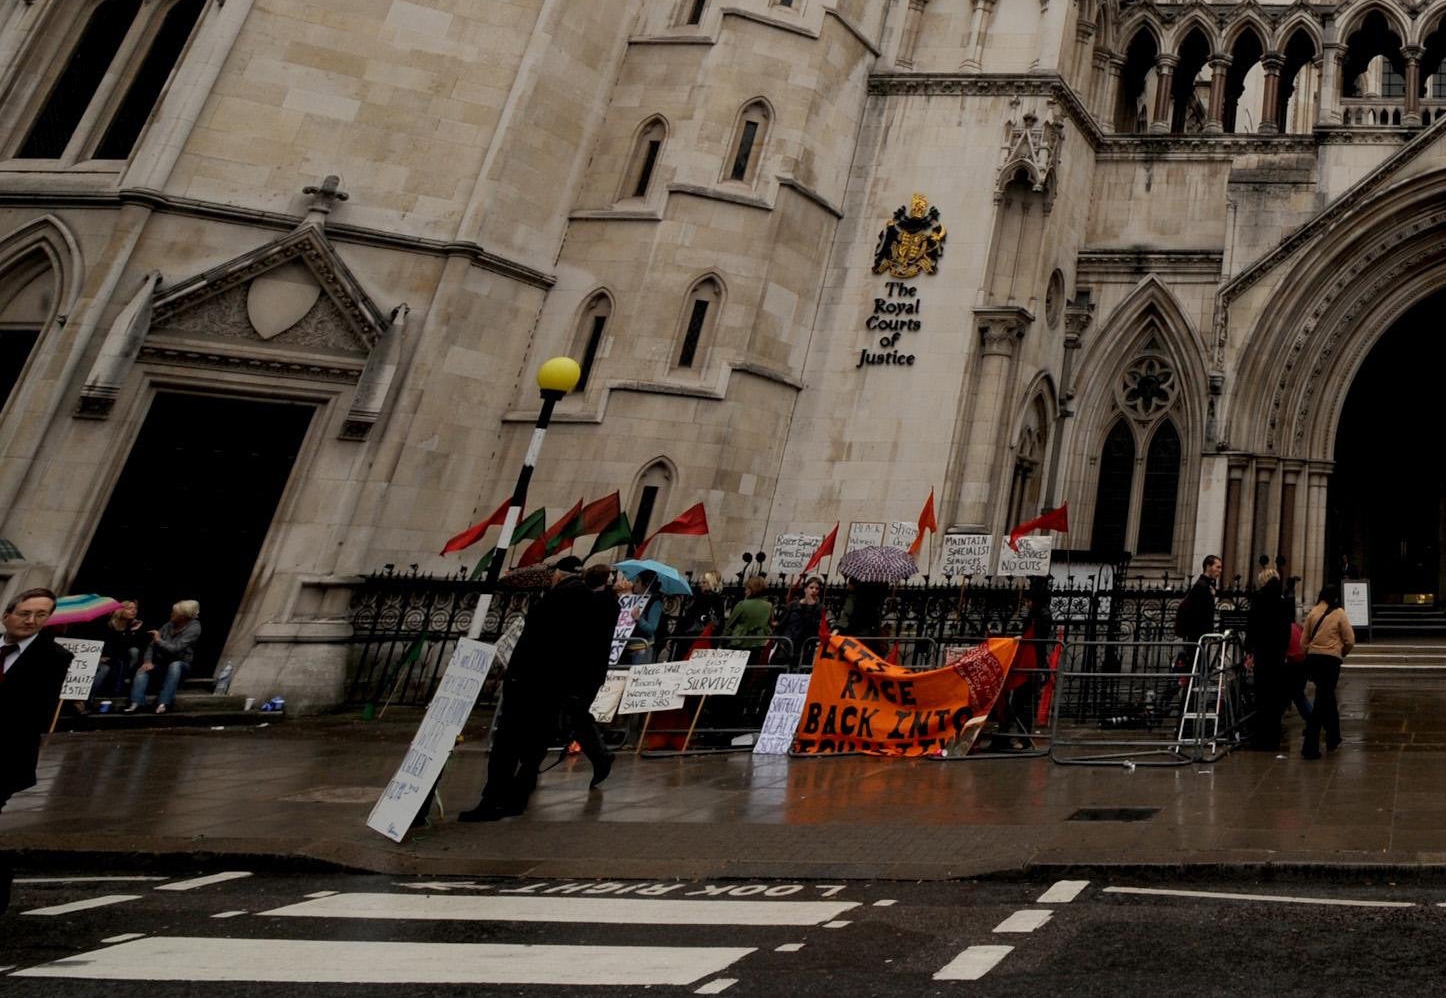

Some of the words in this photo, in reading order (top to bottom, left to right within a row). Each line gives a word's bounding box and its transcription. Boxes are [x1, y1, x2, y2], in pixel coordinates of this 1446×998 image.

[885, 281, 918, 298] The
[873, 298, 921, 317] Royal
[866, 316, 922, 332] Courts
[879, 332, 902, 348] of
[856, 349, 916, 369] Justice
[945, 535, 988, 546] MAINTAIN
[948, 546, 990, 557] SPECIALIST
[943, 565, 967, 576] SAVE
[970, 564, 988, 576] SBS
[1001, 560, 1017, 572] NO
[1018, 560, 1042, 572] CUTS
[619, 595, 650, 609] SAVE
[61, 642, 103, 654] OHESION
[633, 664, 661, 676] Where
[730, 666, 741, 674] TO
[775, 676, 809, 695] SAVE
[840, 669, 917, 707] RACE
[627, 688, 657, 698] Women
[623, 699, 647, 710] SAVE
[652, 697, 671, 707] SBS
[802, 702, 880, 739] BACK
[886, 705, 976, 740] INTO
[499, 882, 687, 897] RIGHT
[684, 884, 848, 899] LOOK
